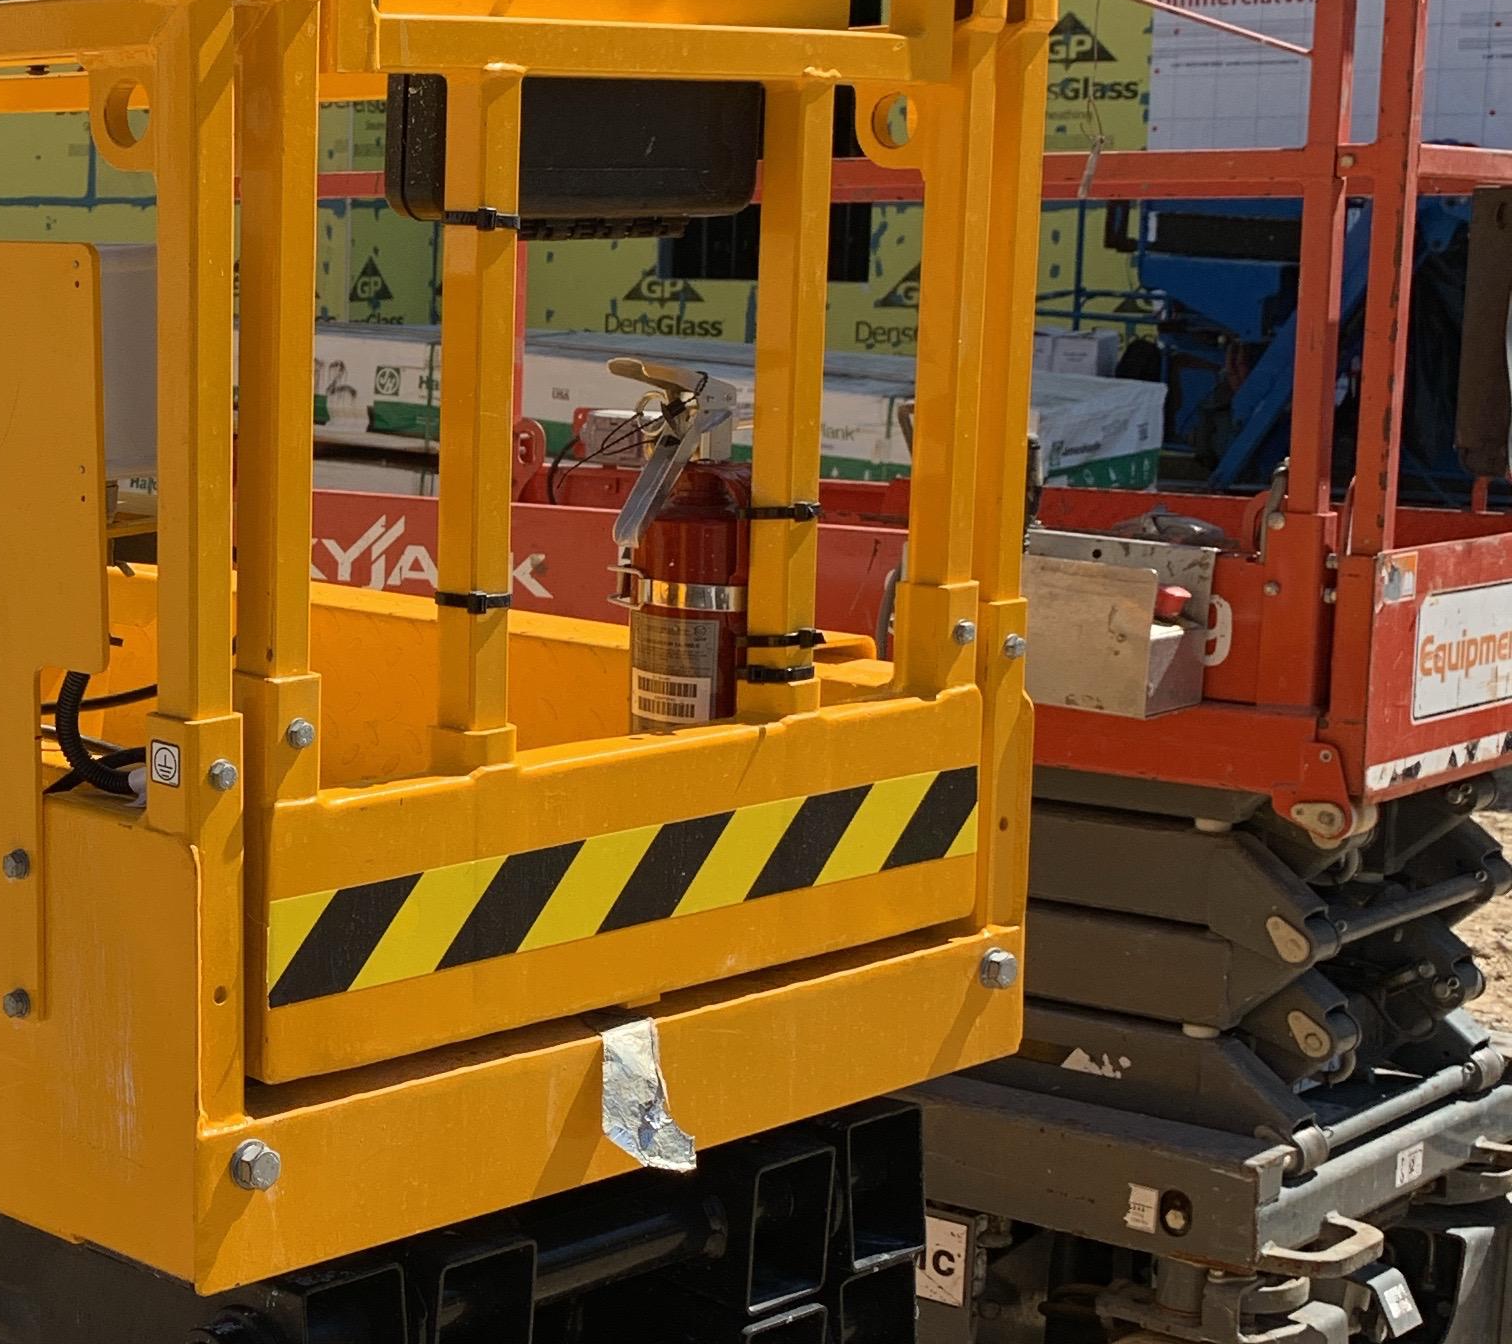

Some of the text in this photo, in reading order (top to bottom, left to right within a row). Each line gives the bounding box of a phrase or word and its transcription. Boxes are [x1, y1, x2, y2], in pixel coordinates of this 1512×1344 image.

[356, 275, 382, 294] GP
[640, 277, 684, 299] GP
[604, 313, 724, 338] DensGlass
